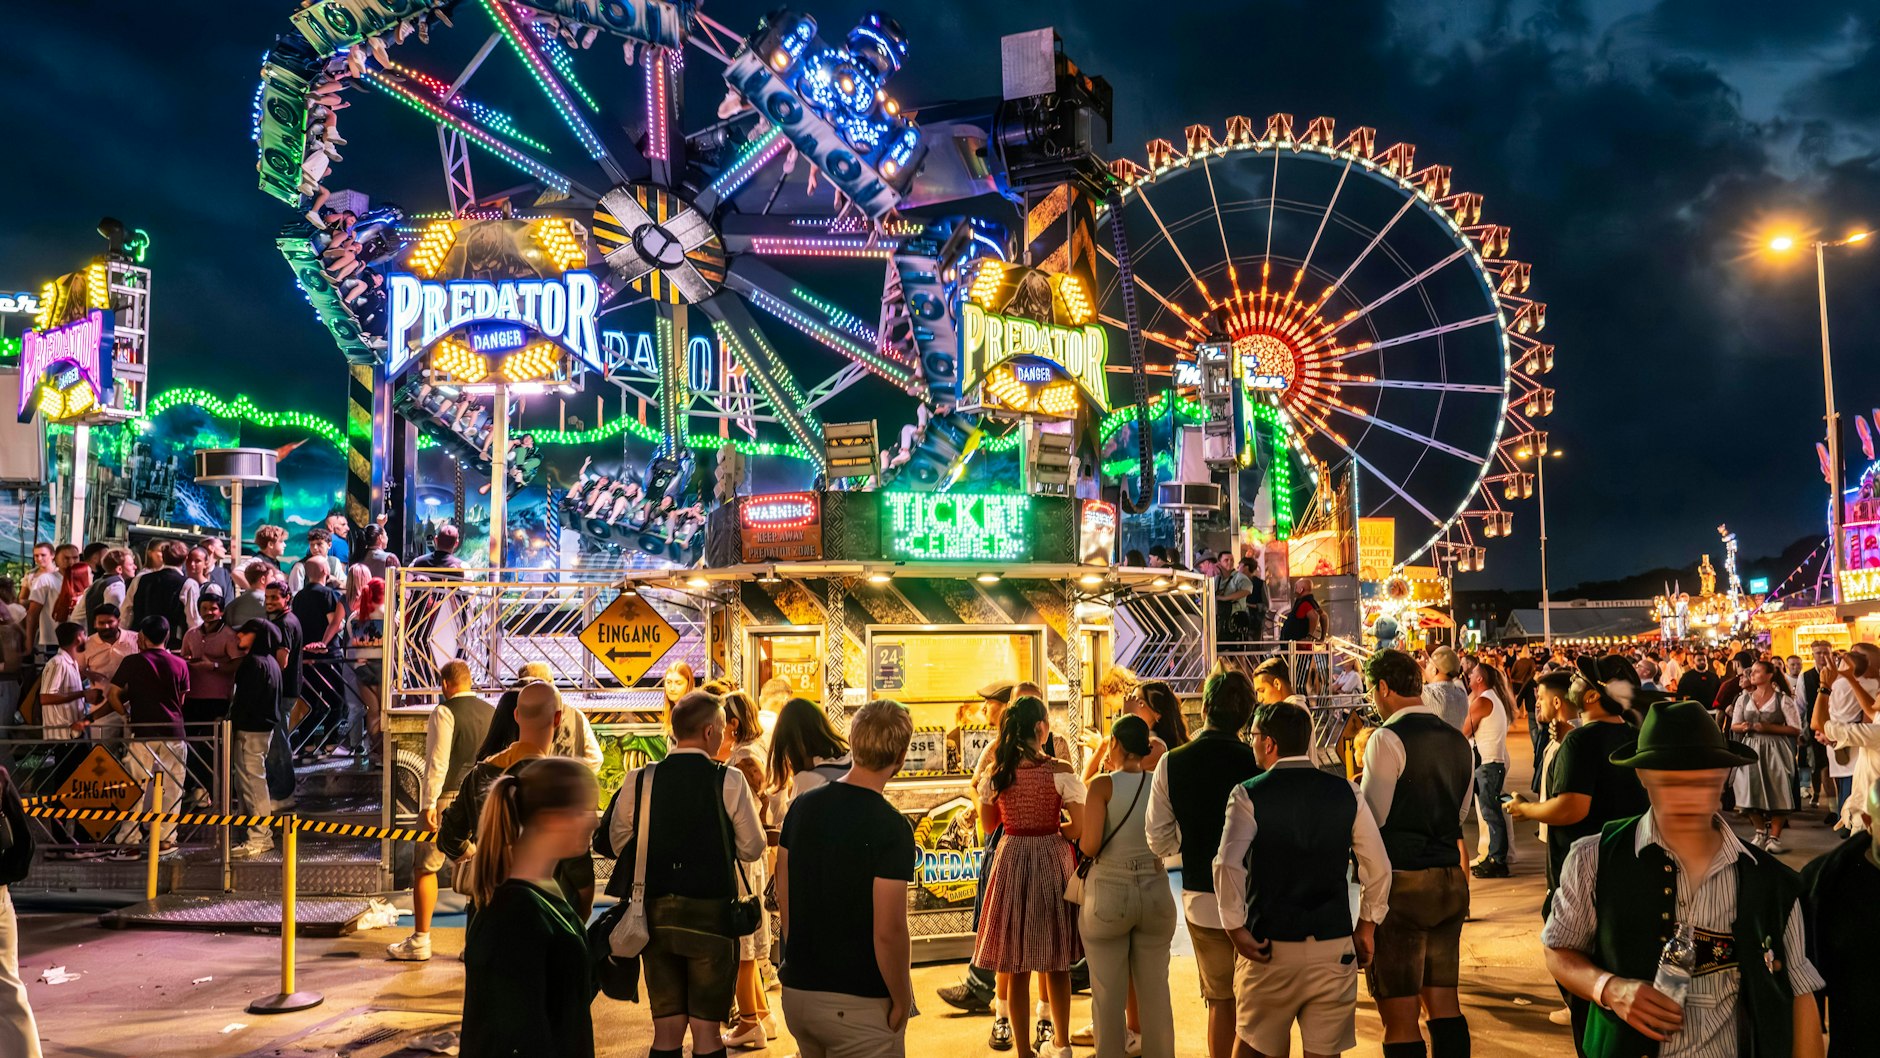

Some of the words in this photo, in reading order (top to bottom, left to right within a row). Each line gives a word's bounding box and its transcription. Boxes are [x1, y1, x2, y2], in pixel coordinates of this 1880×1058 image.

[388, 271, 604, 377] PREDATOR
[473, 330, 522, 351] DANGER
[21, 311, 102, 412] PREDATOR
[963, 302, 1112, 413] PREDATOR
[1017, 366, 1051, 381] DANGER
[749, 504, 811, 520] WARNING
[884, 492, 1029, 532] TICKET
[757, 531, 777, 543] KEEP
[780, 530, 805, 542] AWAY
[909, 532, 1014, 557] CENTER
[749, 546, 792, 558] PREDATOR
[793, 545, 816, 556] ZONE
[1849, 574, 1880, 597] MA
[598, 623, 660, 643] EINGANG
[880, 649, 899, 664] 24
[775, 662, 815, 674] TICKETS
[910, 741, 935, 752] SSE
[71, 779, 126, 799] EINGANG
[908, 844, 985, 886] PREDAT
[950, 889, 975, 900] DANGER
